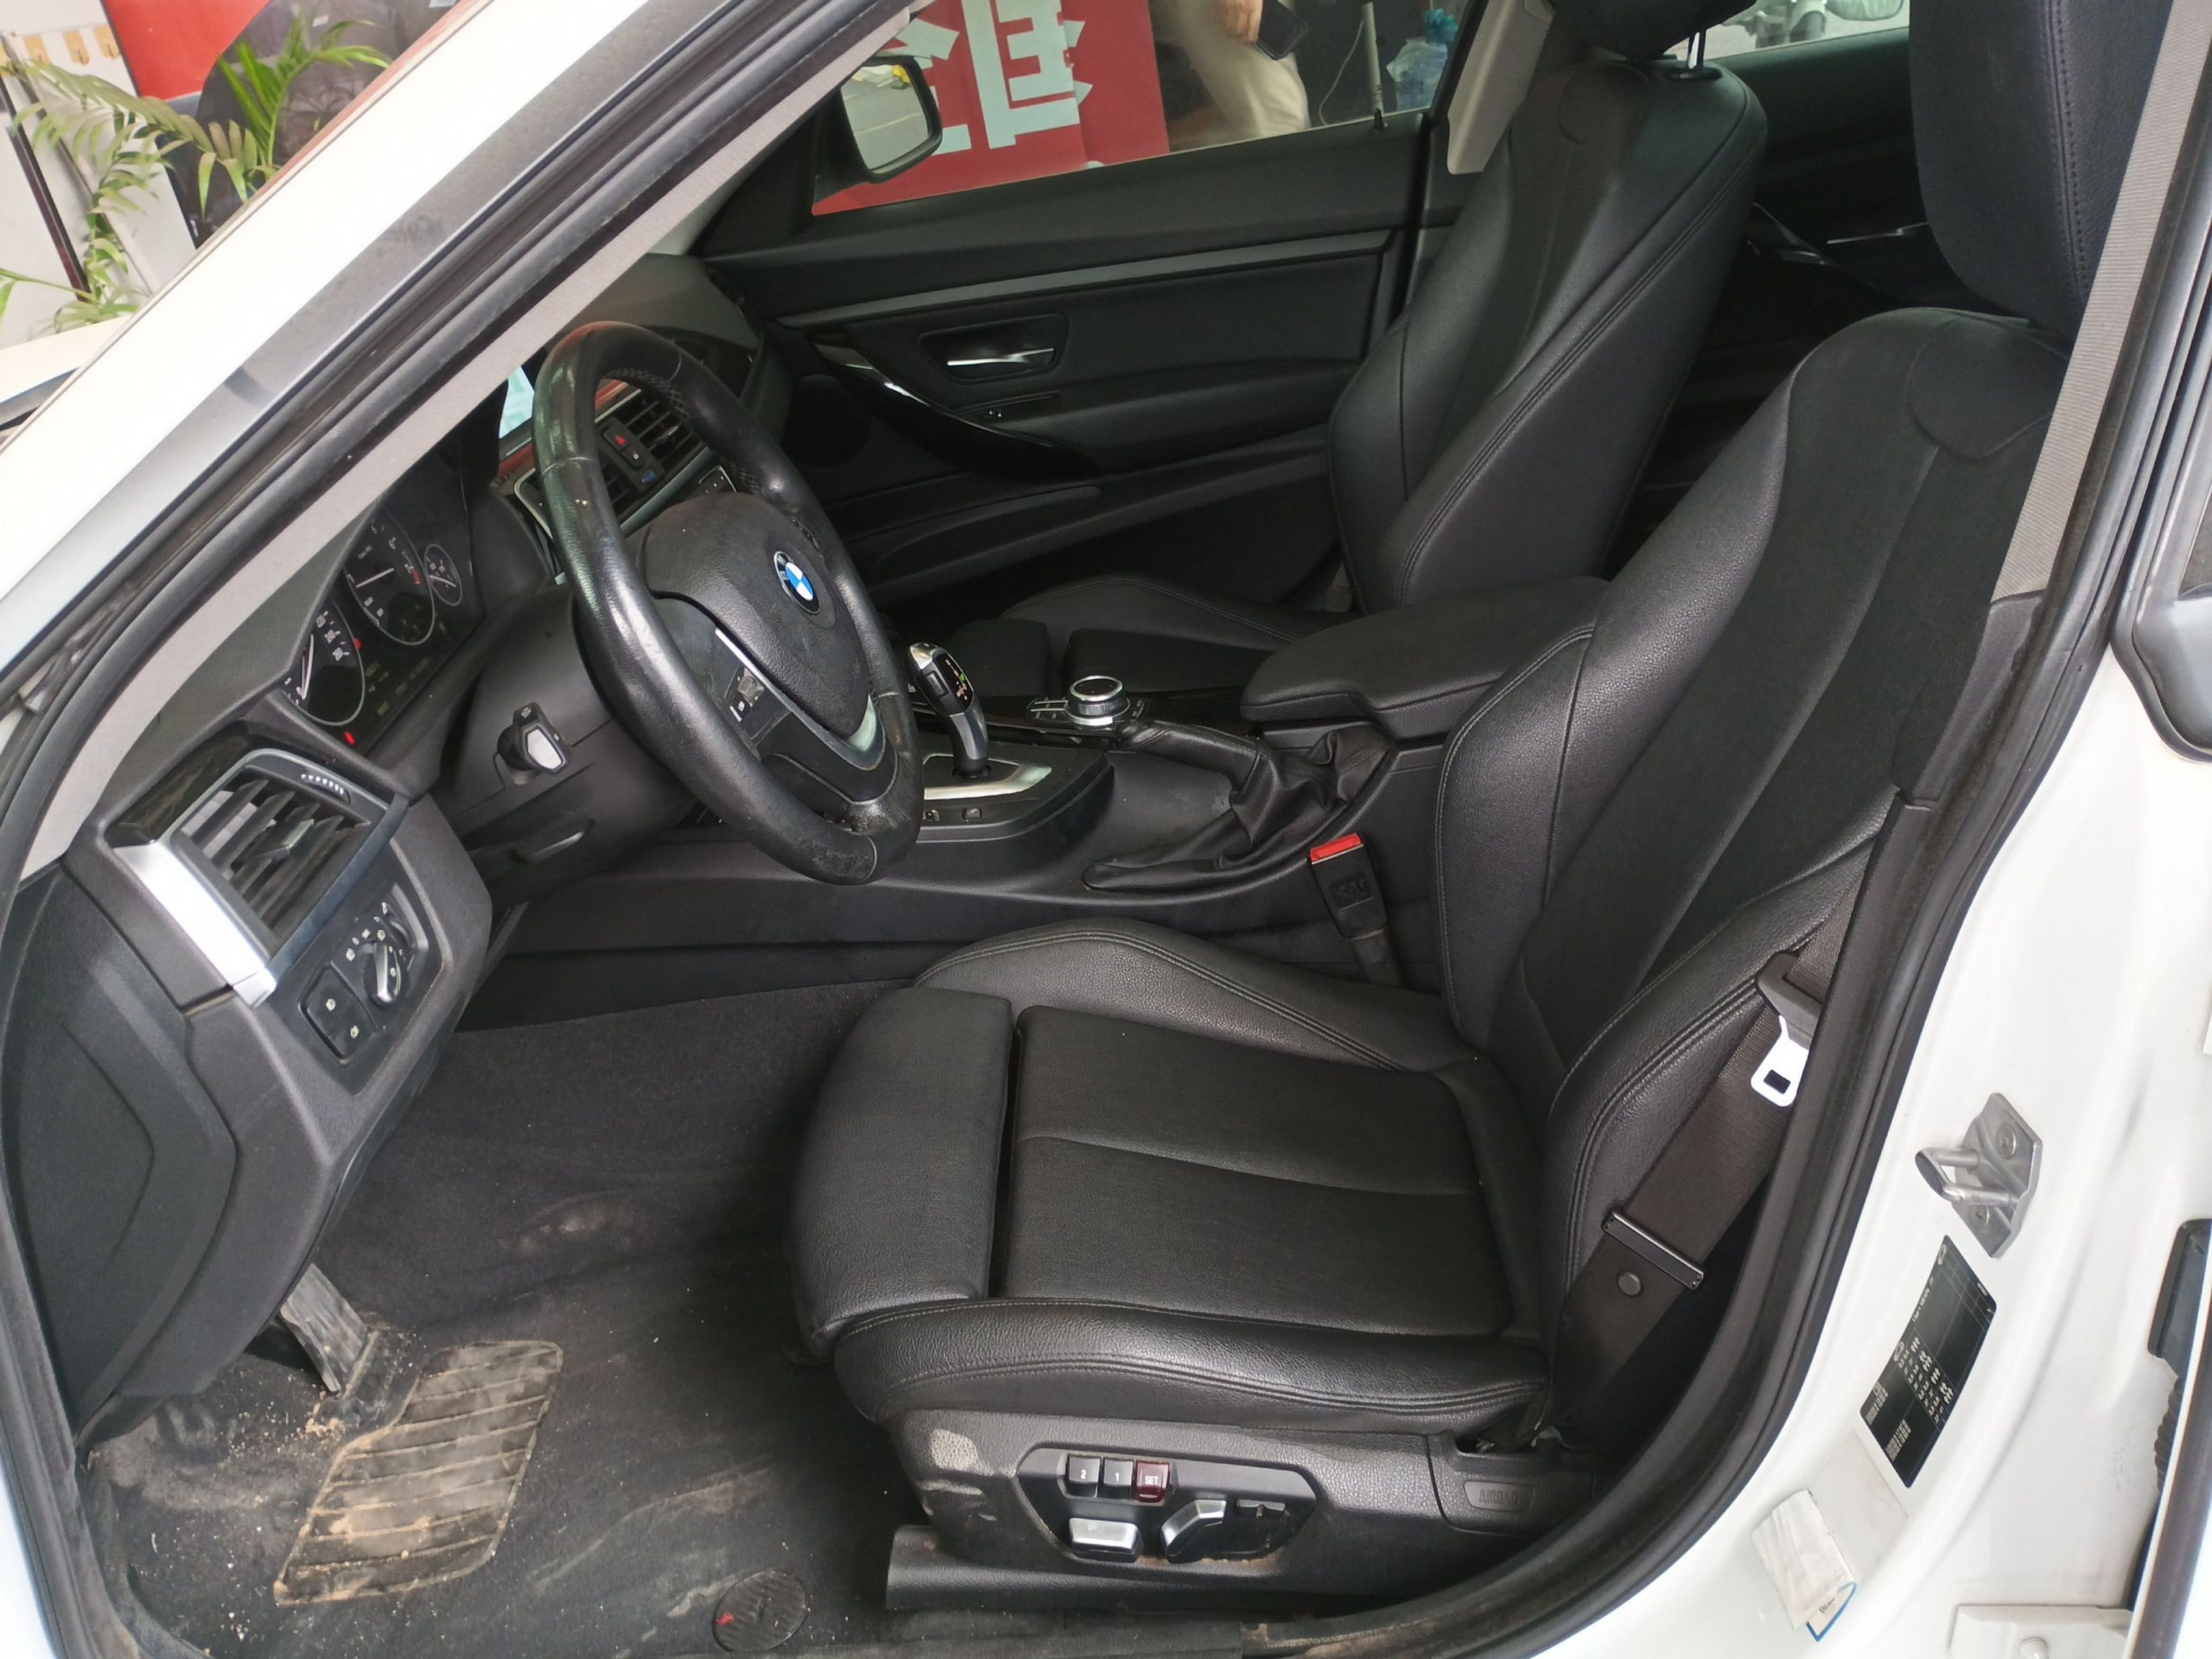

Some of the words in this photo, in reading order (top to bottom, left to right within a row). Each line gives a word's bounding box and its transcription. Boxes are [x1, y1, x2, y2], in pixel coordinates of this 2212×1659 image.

[1081, 1469, 1086, 1479] 2
[1115, 1472, 1119, 1482] 1
[1145, 1475, 1159, 1485] SET
